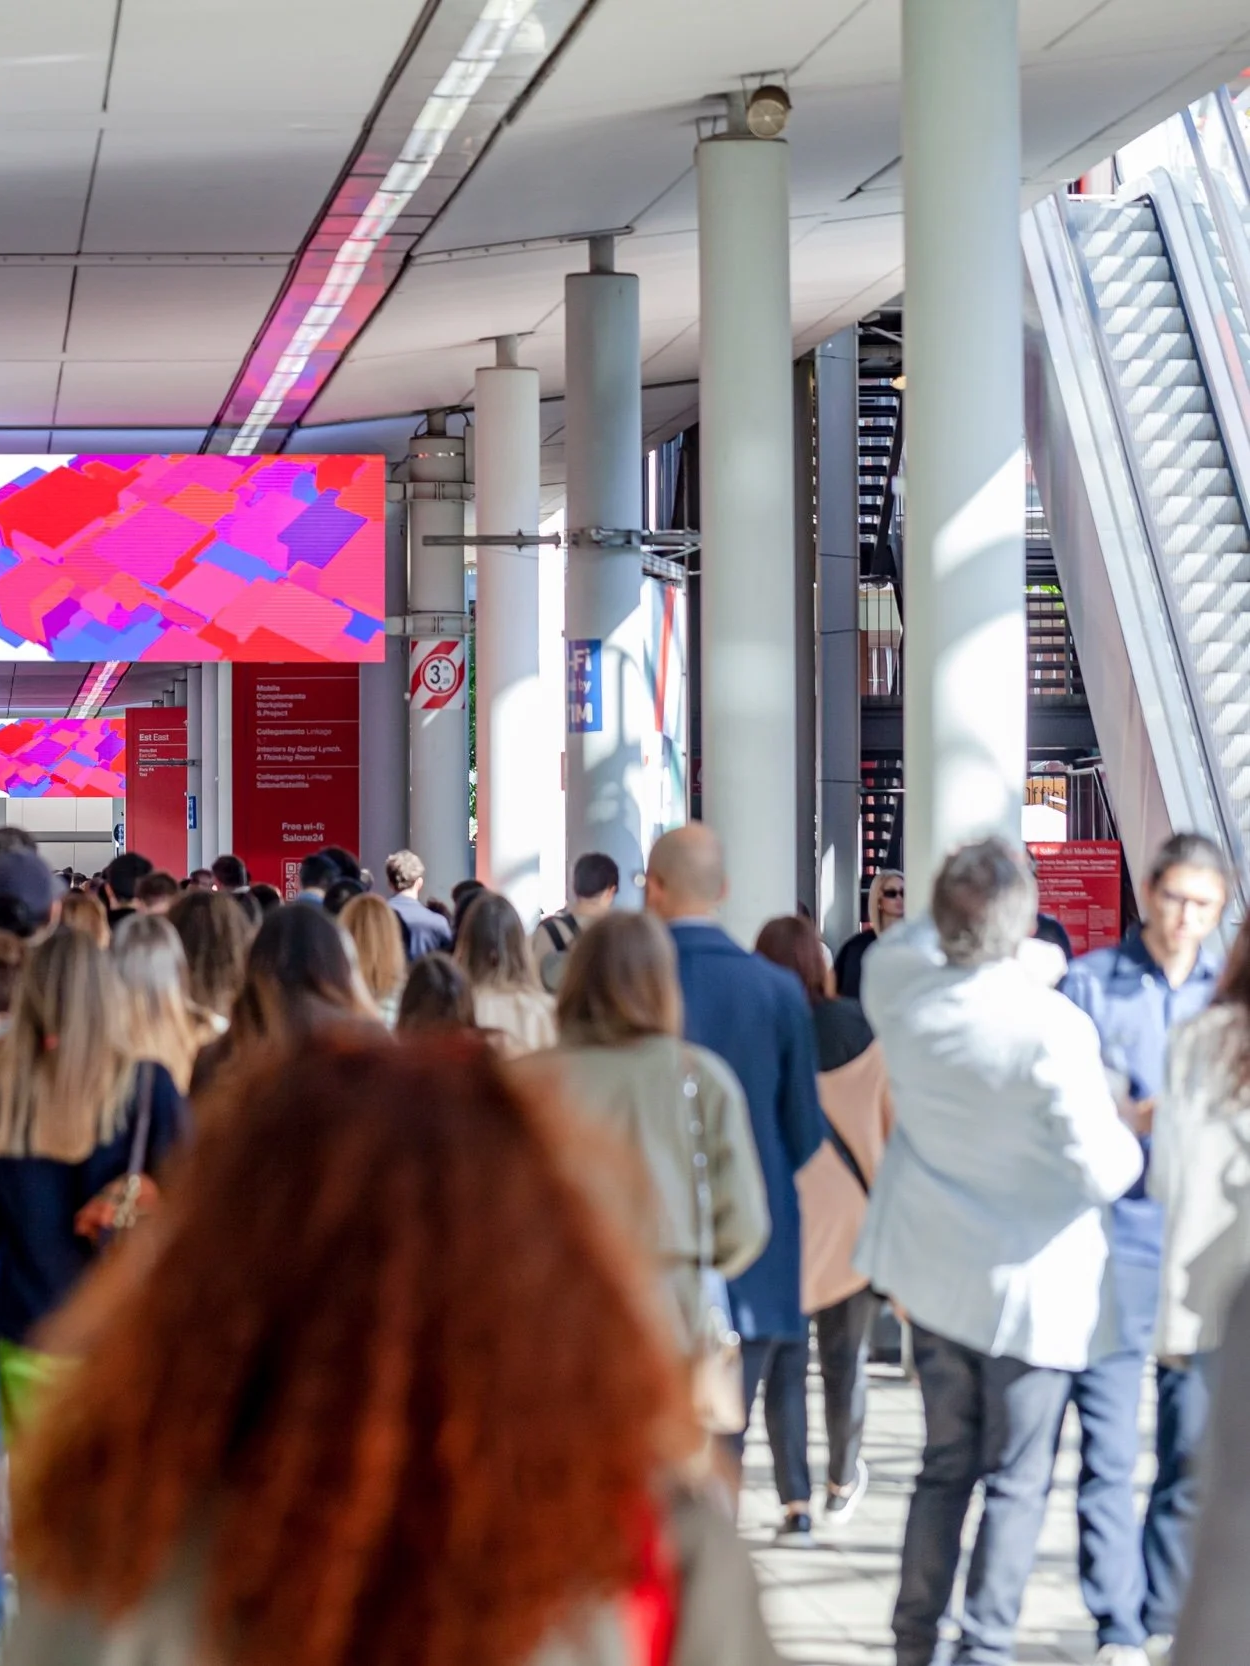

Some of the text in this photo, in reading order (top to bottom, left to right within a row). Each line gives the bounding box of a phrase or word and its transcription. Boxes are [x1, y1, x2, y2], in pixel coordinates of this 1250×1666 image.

[256, 702, 294, 710] Workplace
[256, 728, 333, 736] Collegamento Linkage
[139, 733, 170, 742] Est East
[287, 746, 296, 754] by
[297, 745, 318, 753] David
[318, 745, 342, 754] Lynch.
[263, 754, 294, 762] Thinking
[256, 773, 333, 782] Collegamento Linkage
[281, 822, 326, 831] Free wi-fi:
[282, 833, 325, 842] Salone24
